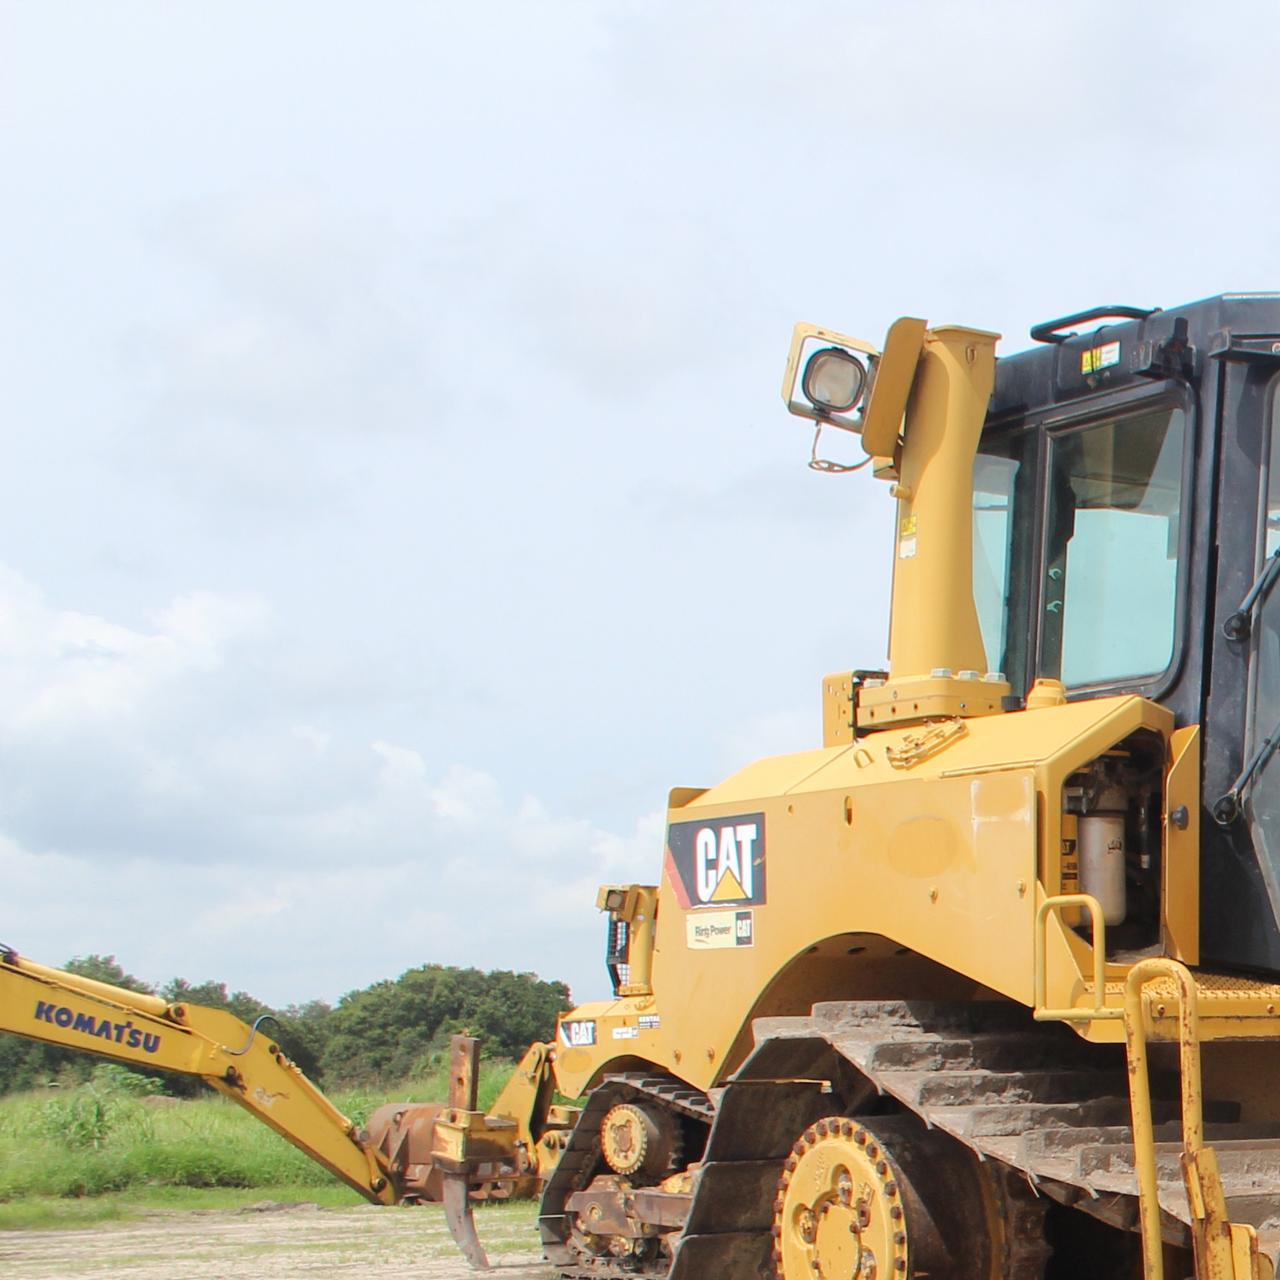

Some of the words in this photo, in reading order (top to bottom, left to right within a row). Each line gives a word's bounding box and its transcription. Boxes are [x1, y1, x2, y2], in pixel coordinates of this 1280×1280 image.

[695, 823, 757, 902] CAT
[695, 926, 709, 938] Ring
[710, 925, 731, 936] Power
[737, 919, 751, 938] CAT
[35, 1001, 161, 1053] KOMATSU
[571, 1022, 595, 1045] CAT
